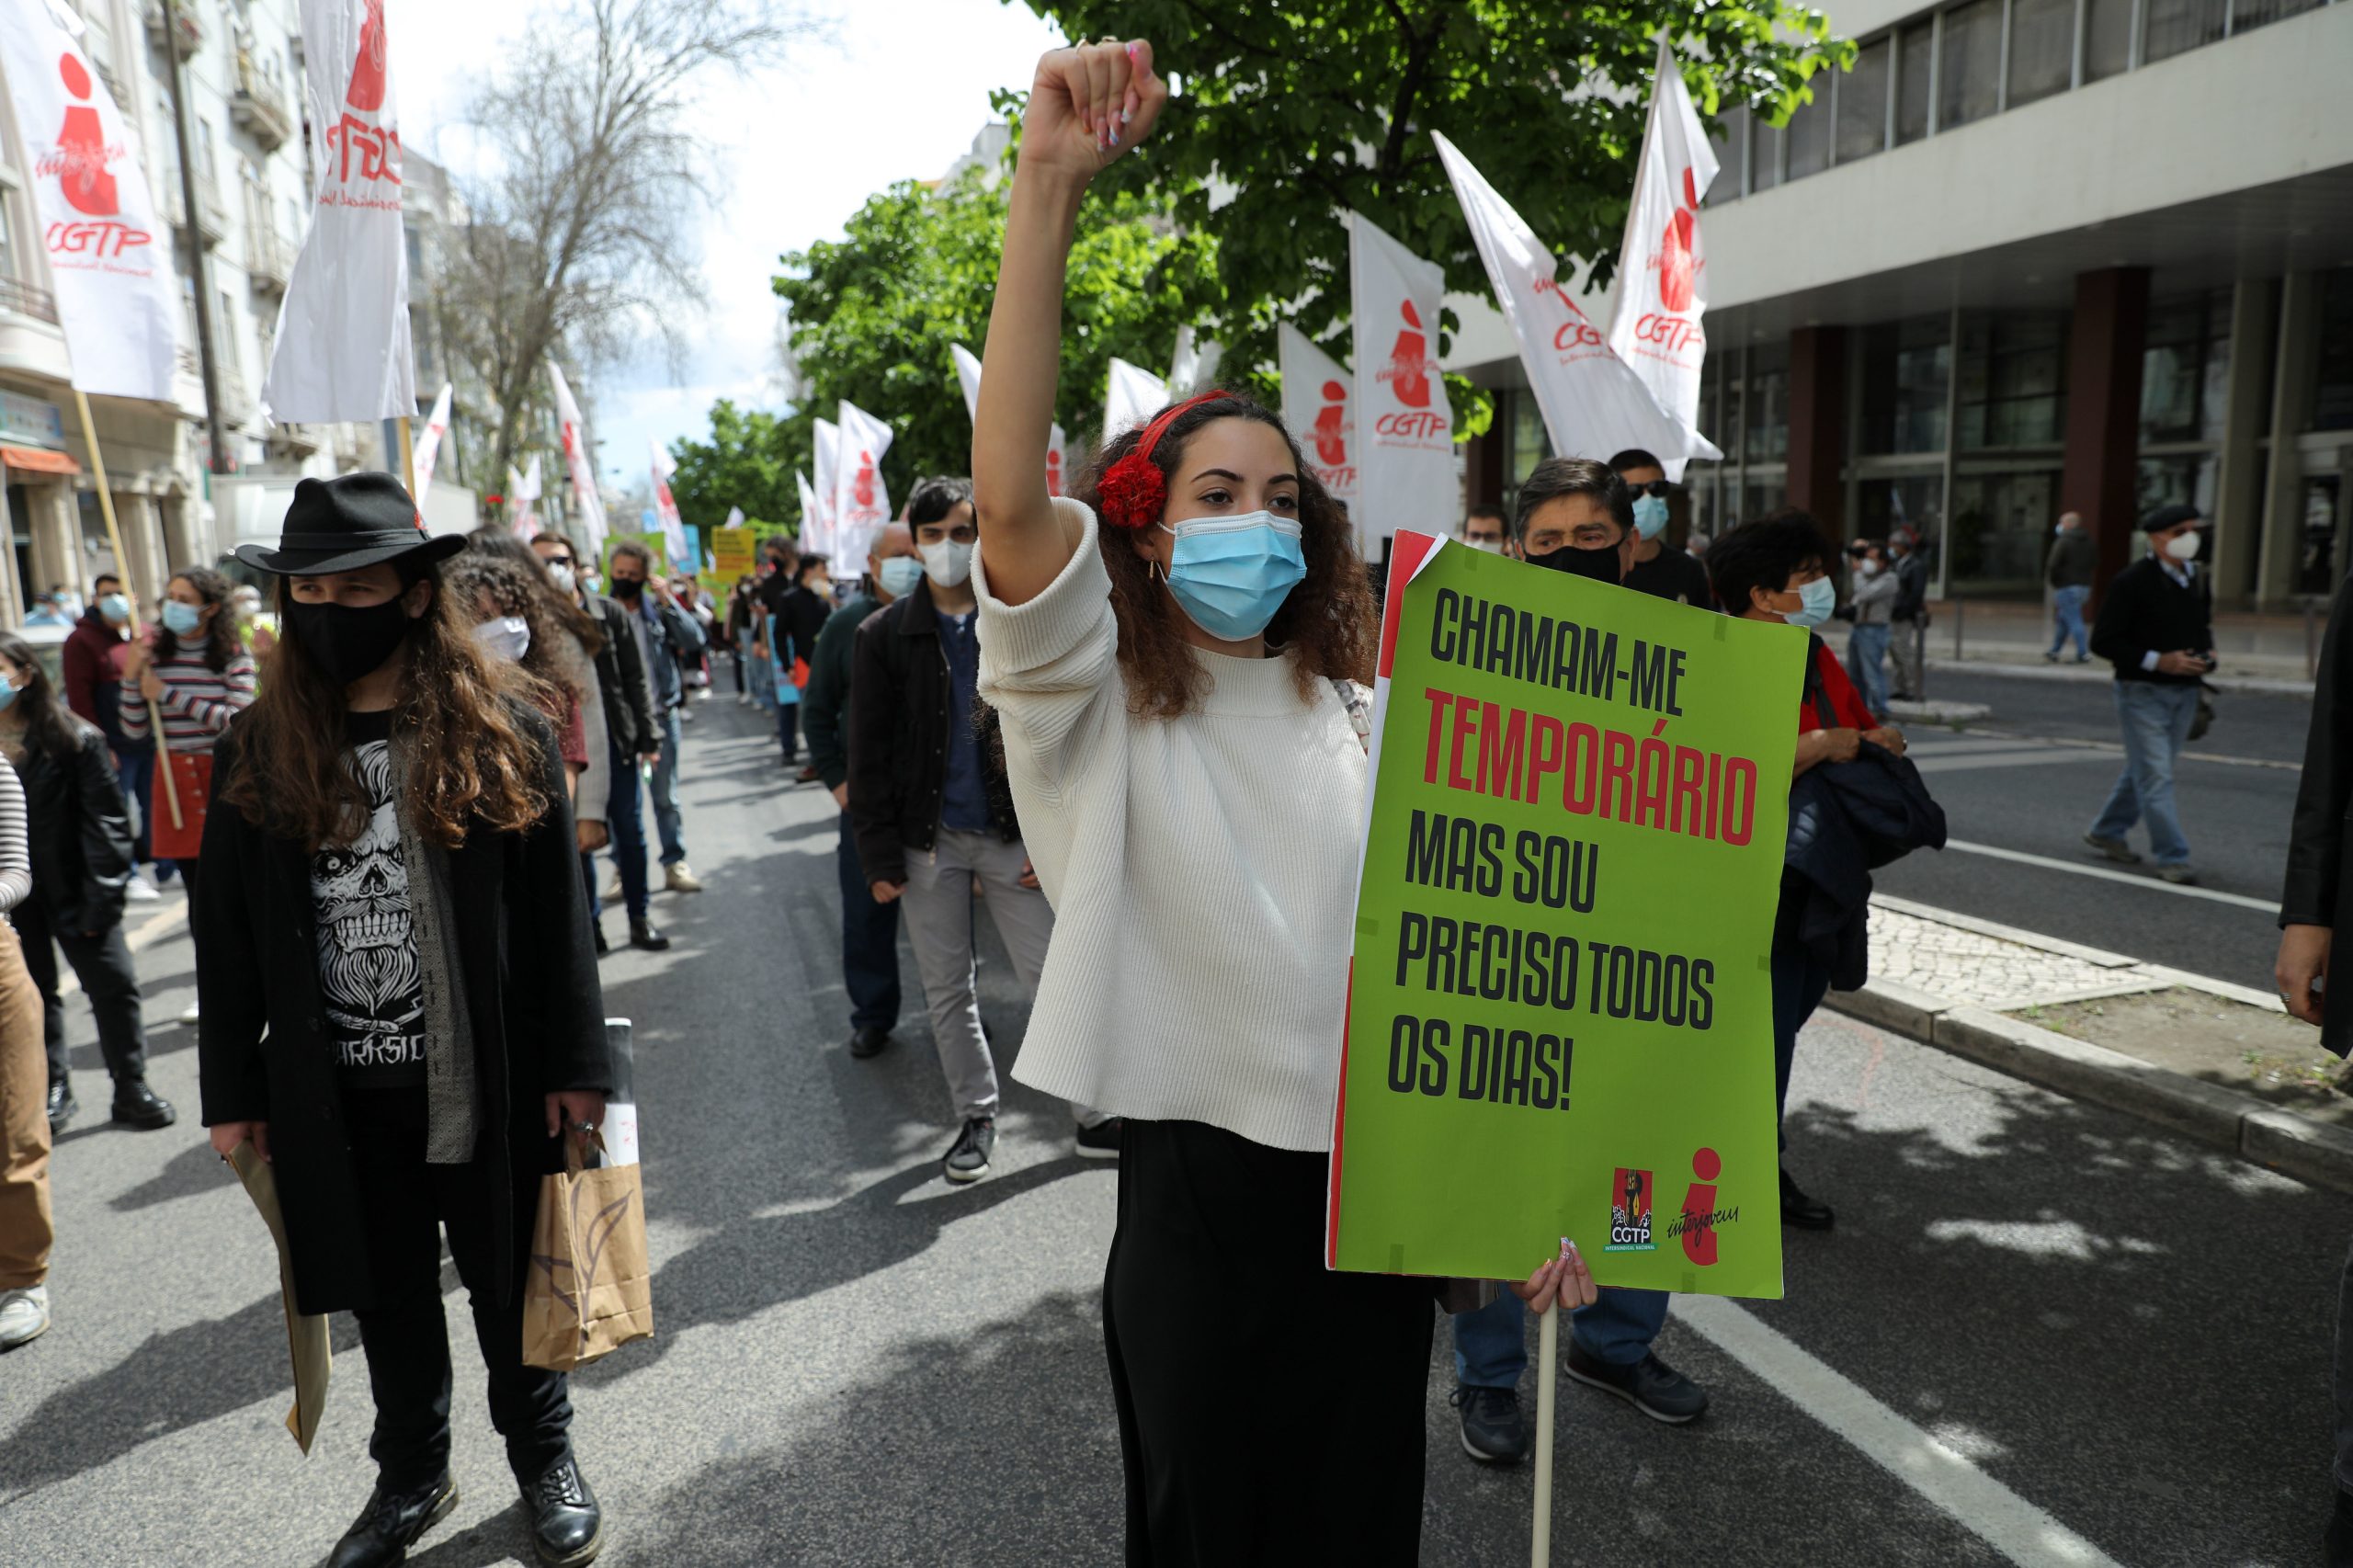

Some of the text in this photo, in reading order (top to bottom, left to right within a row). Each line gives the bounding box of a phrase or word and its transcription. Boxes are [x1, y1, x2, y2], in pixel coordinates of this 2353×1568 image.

[46, 222, 152, 257] CGTP
[1553, 323, 1601, 351] CG
[1635, 313, 1702, 352] CGTP
[1375, 411, 1448, 438] CGTP
[1430, 588, 1687, 717] CHAMAM-ME
[1424, 687, 1757, 847] TEMPORÁRIO
[1405, 810, 1598, 914] MAS SOU
[1395, 911, 1714, 1030] PRECISO TODOS
[335, 1034, 426, 1065] ARKSID
[1387, 1015, 1574, 1111] OS DIAS!
[1611, 1226, 1651, 1244] CGTP
[1667, 1206, 1739, 1248] interjovem
